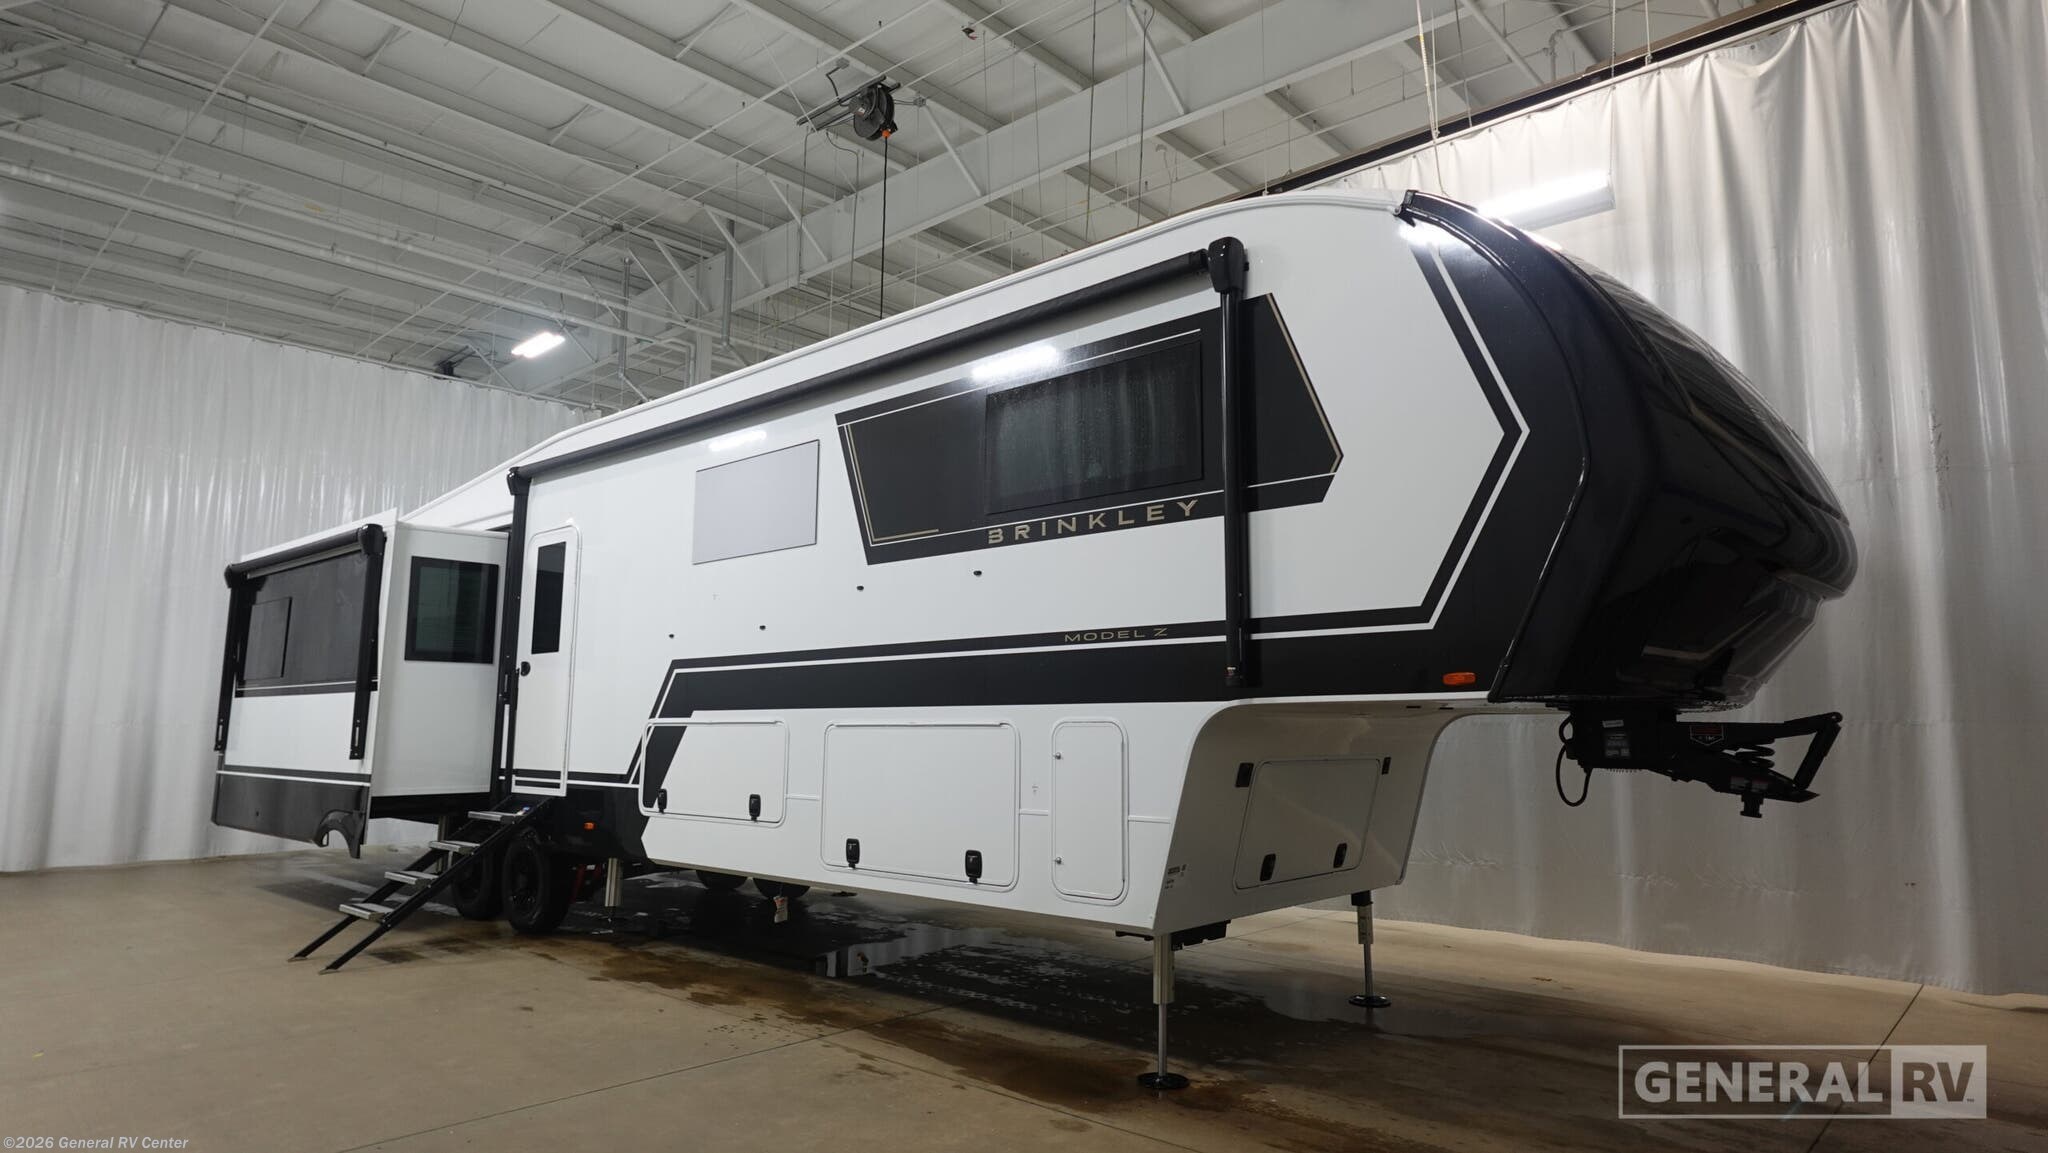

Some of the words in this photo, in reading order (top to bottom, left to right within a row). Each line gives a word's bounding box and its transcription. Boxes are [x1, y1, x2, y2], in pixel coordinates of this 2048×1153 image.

[987, 499, 1199, 545] BRINKLEY
[1064, 629, 1146, 643] MODEL
[1153, 627, 1169, 638] Z
